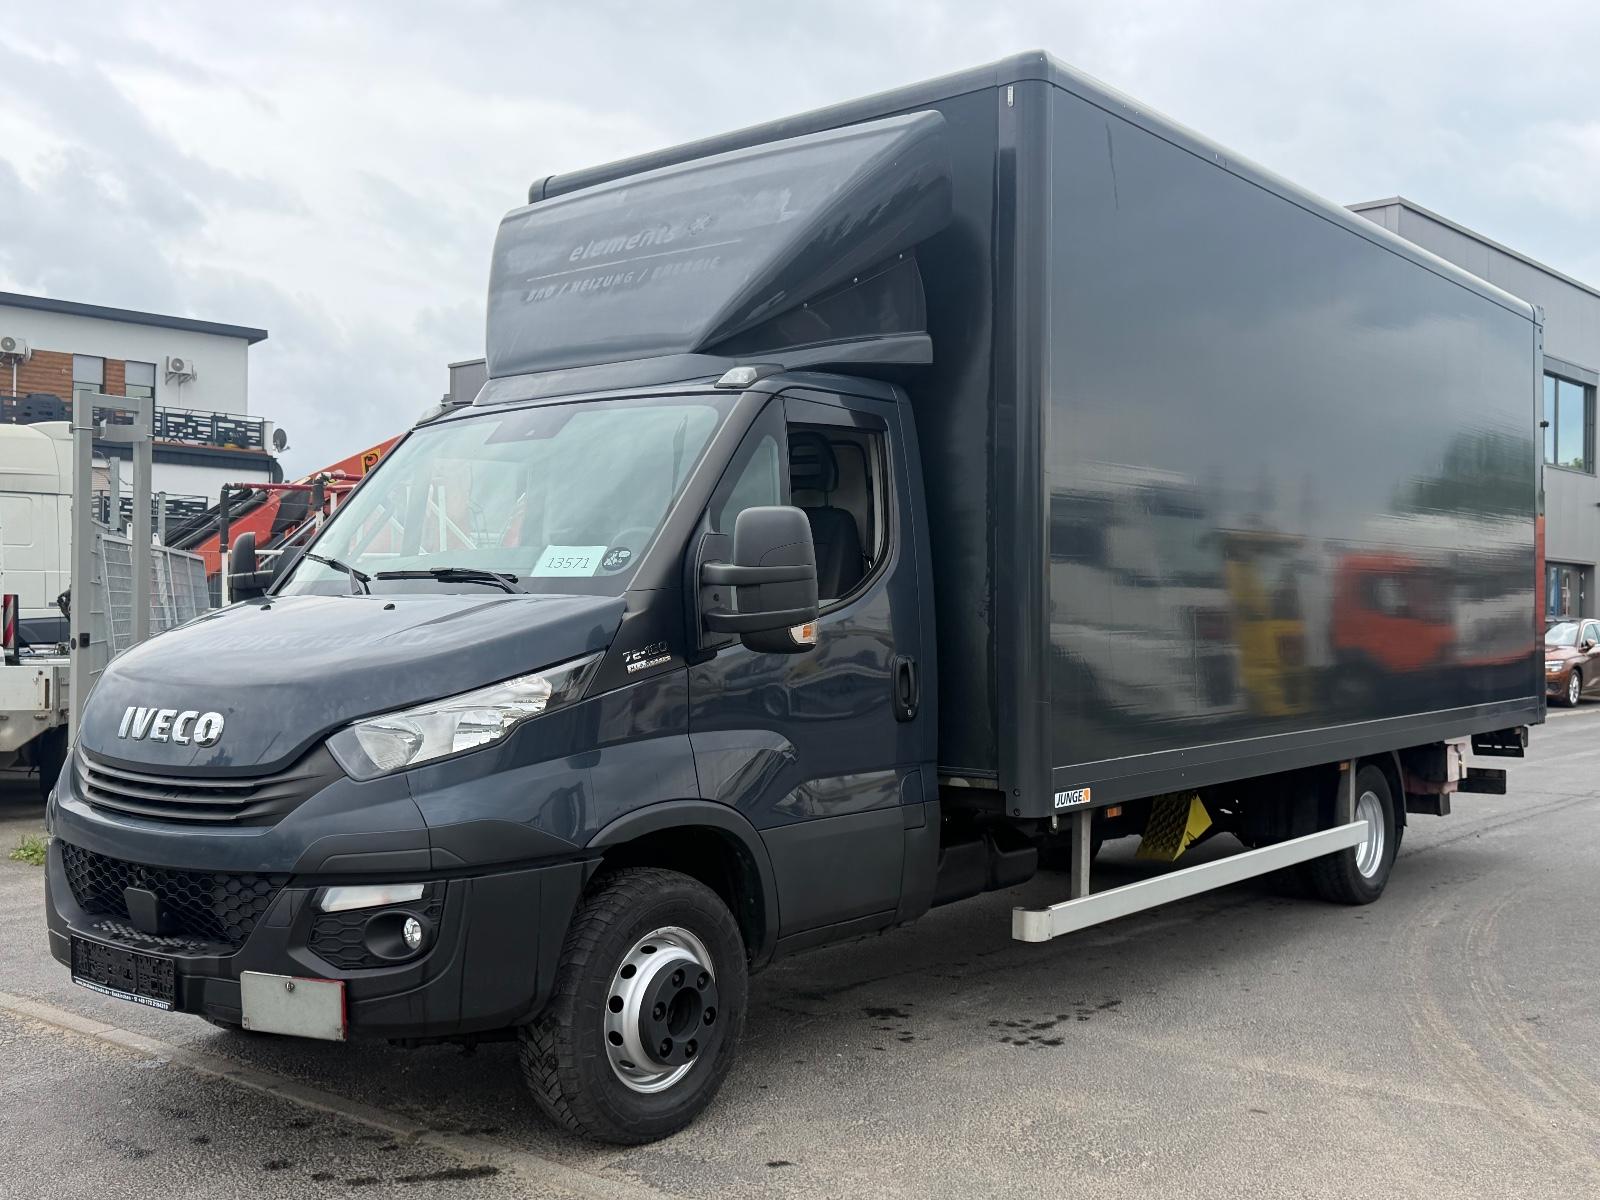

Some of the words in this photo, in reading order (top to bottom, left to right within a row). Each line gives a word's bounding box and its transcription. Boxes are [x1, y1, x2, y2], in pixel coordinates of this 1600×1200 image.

[569, 225, 676, 262] elements
[570, 271, 634, 293] HEIZUNG
[545, 557, 590, 569] 13571
[117, 706, 225, 748] IVECO
[1056, 790, 1083, 806] JUNGE
